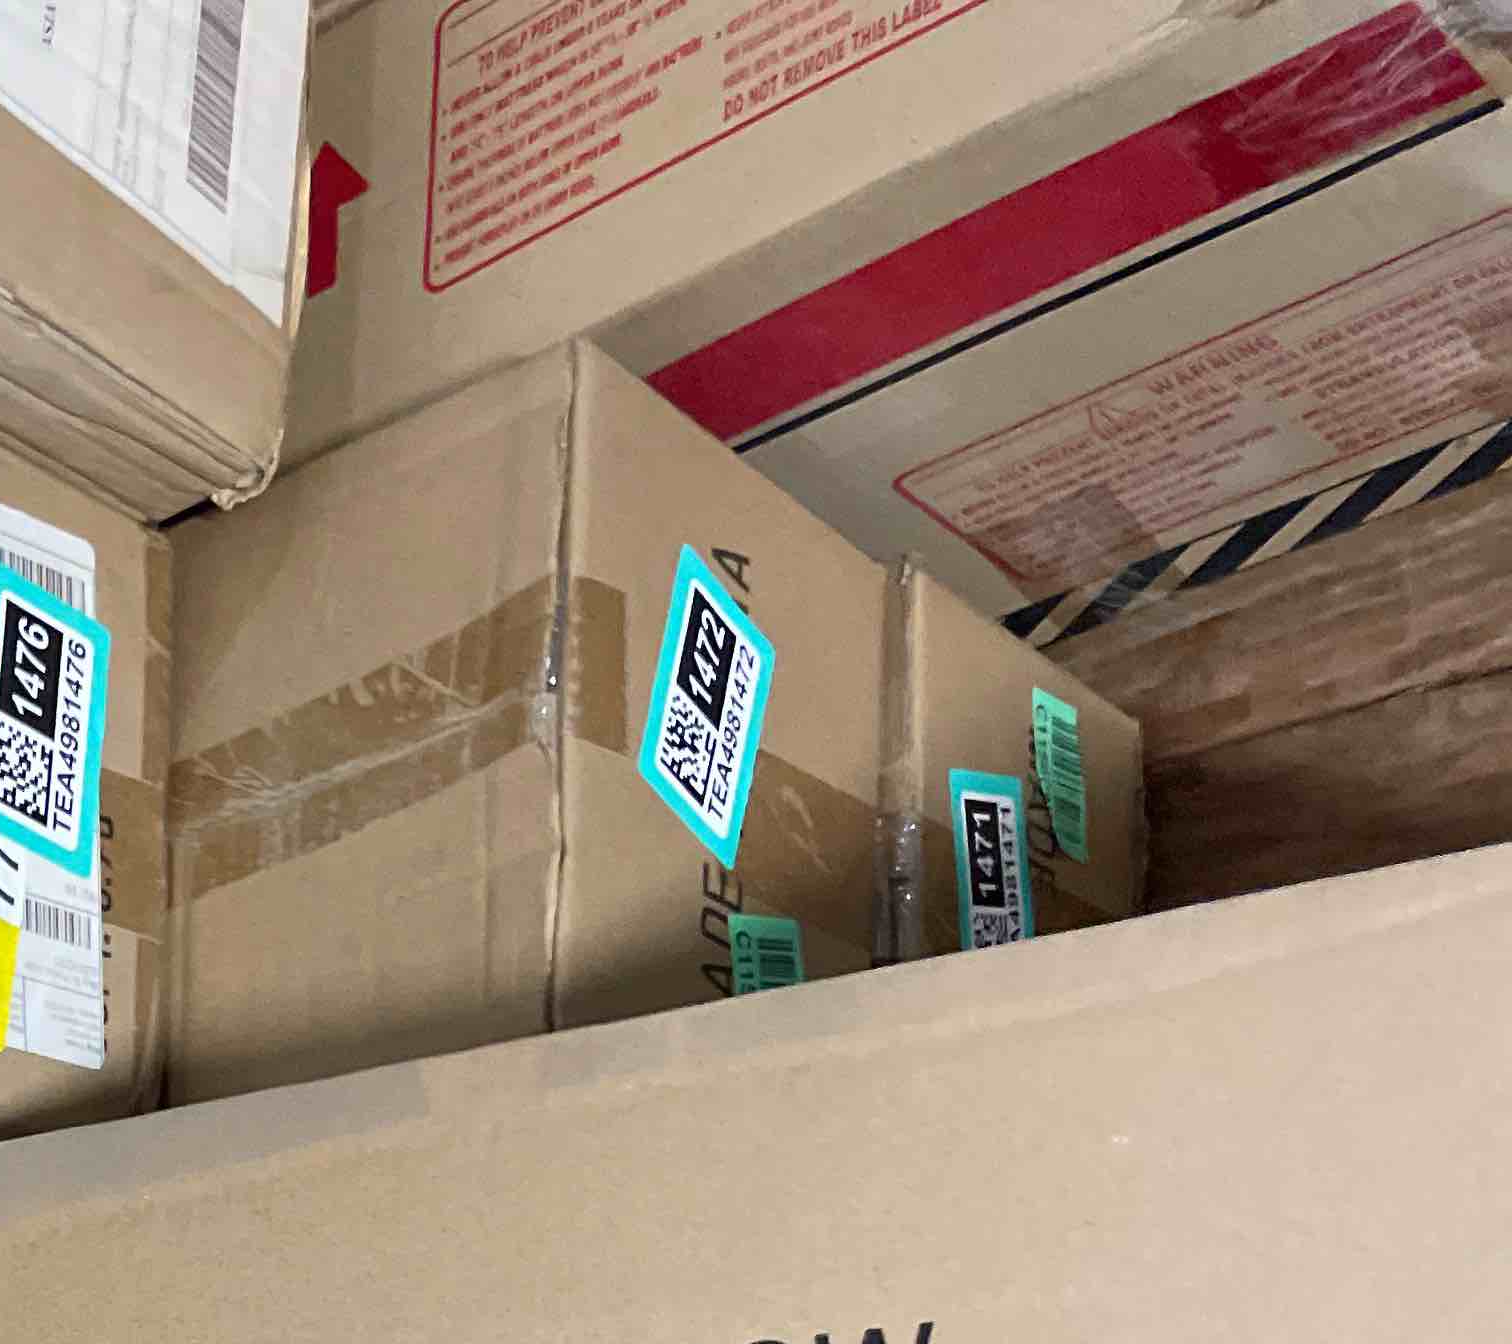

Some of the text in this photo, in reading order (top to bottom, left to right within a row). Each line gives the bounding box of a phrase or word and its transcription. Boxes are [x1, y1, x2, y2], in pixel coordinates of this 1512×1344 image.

[852, 17, 887, 50] THIS
[10, 613, 52, 720] 1476
[689, 608, 728, 713] 1472
[53, 638, 88, 832] TEA4981476
[706, 643, 756, 821] TEA4981472
[975, 810, 994, 899] 1471
